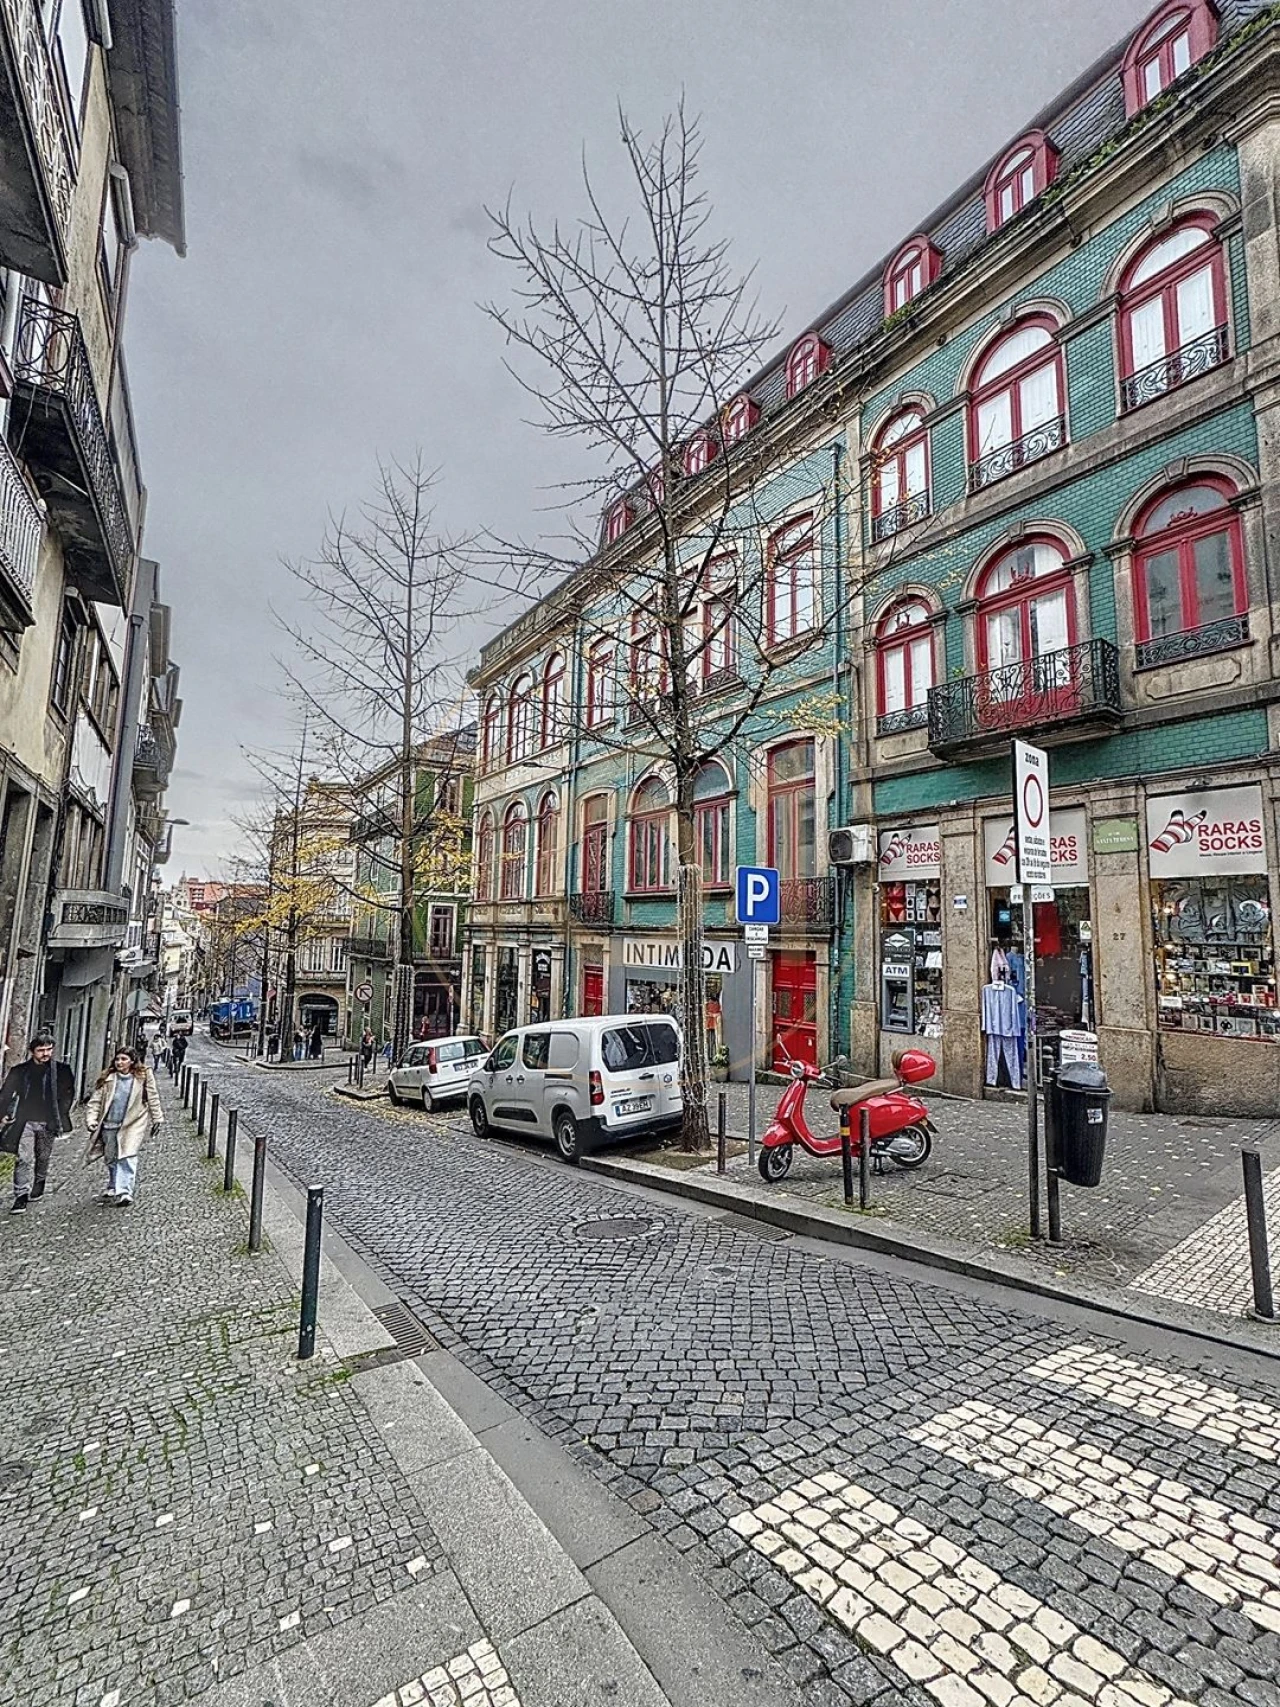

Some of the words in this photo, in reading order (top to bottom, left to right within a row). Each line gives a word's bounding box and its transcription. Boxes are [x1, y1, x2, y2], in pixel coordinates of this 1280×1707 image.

[1024, 752, 1040, 767] zona
[1198, 820, 1261, 837] RARAS
[907, 841, 940, 853] RARAS
[1049, 835, 1077, 849] RAS
[1199, 835, 1262, 851] SOCKS
[907, 852, 941, 864] SOCKS
[1049, 849, 1078, 862] CKS
[746, 873, 769, 916] P
[1113, 932, 1126, 941] 27
[626, 943, 732, 971] INTIMDA
[885, 966, 908, 975] ATM
